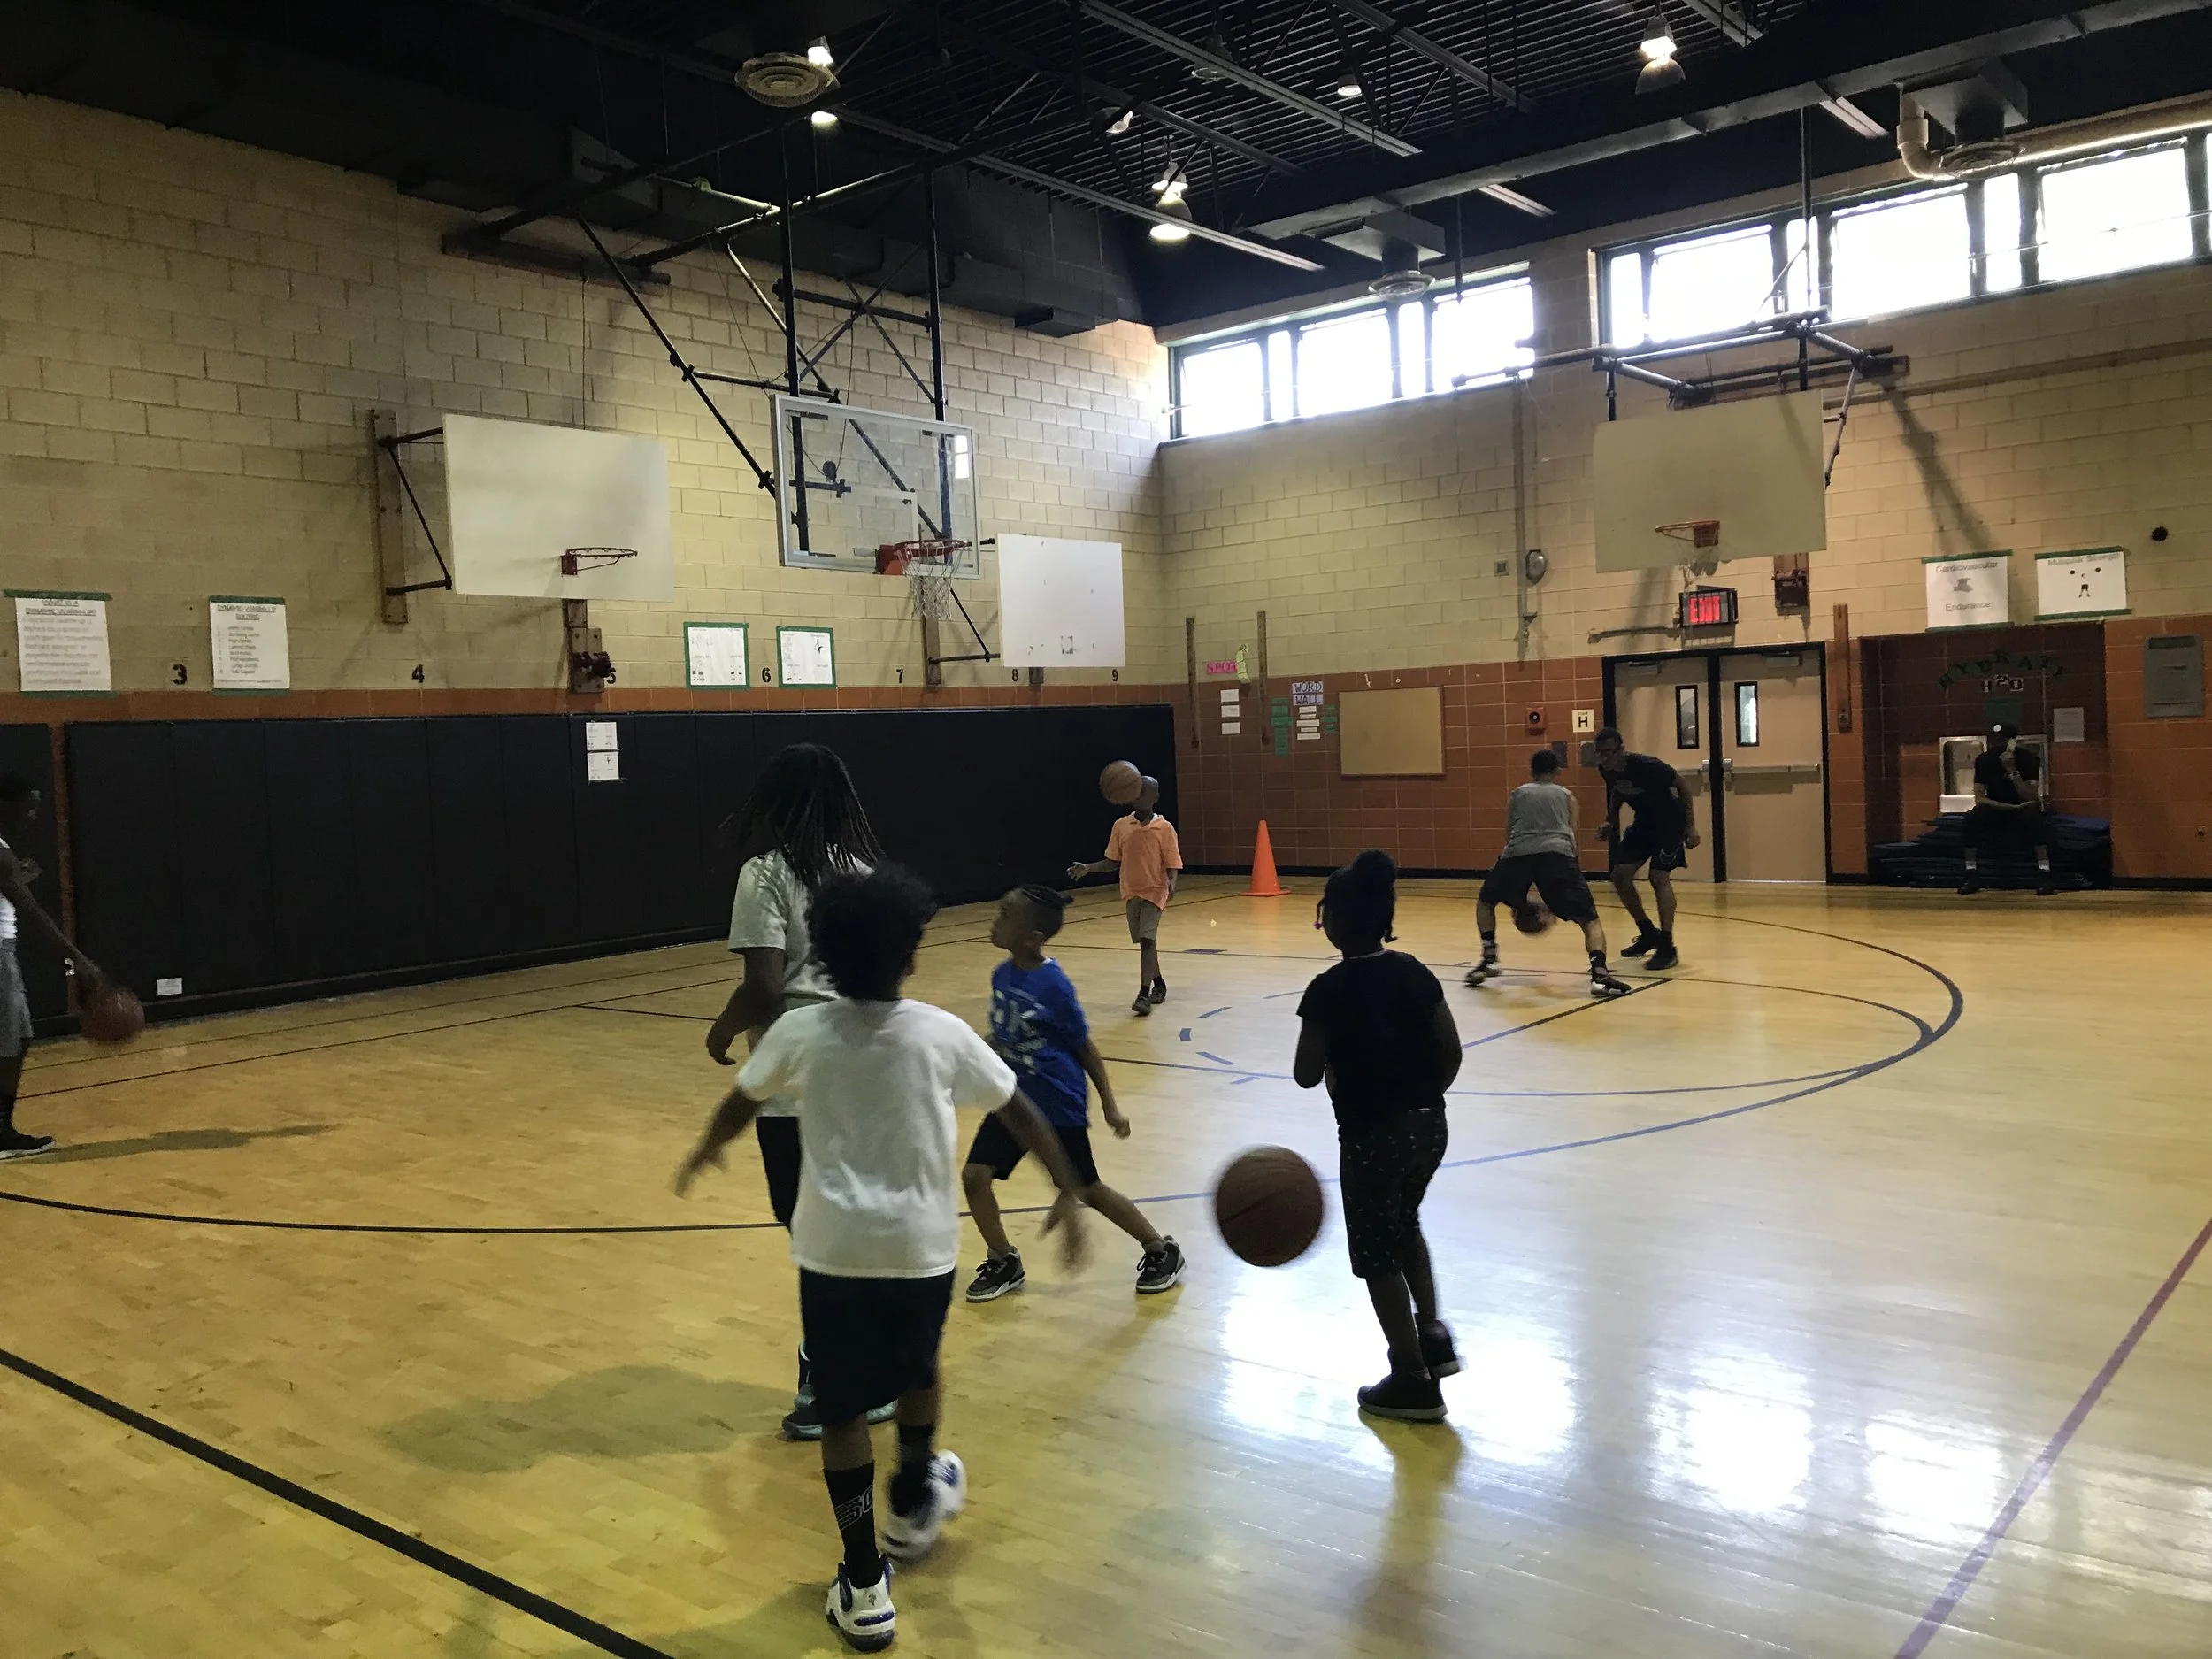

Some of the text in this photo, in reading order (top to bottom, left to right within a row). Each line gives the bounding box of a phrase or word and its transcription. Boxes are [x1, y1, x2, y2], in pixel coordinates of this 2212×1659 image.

[1935, 561, 1999, 573] Cardiovascular
[1689, 595, 1721, 623] EXIT
[1945, 601, 1991, 611] Endurance
[173, 664, 188, 685] 3
[411, 664, 425, 684] 4
[761, 667, 772, 683] 6
[895, 668, 904, 684] 7
[1011, 668, 1018, 682] 8
[1111, 669, 1118, 682] 9
[1294, 681, 1322, 693] WORD
[1295, 694, 1321, 705] WALL
[1578, 715, 1588, 728] H
